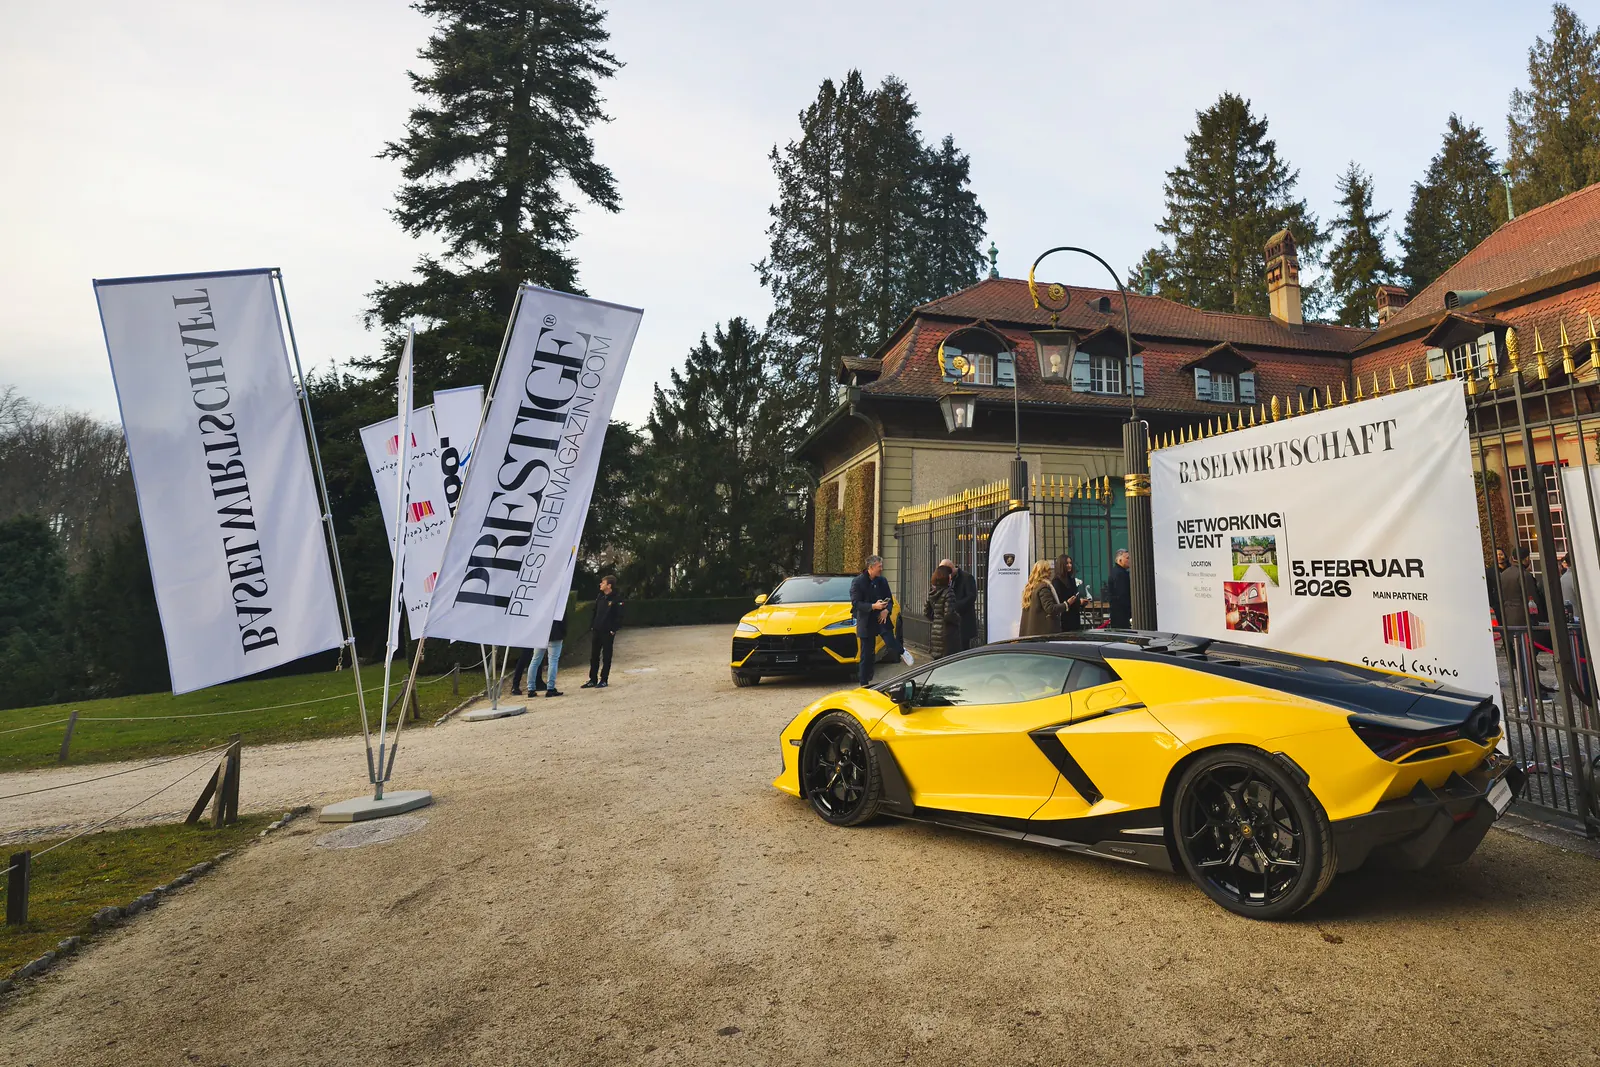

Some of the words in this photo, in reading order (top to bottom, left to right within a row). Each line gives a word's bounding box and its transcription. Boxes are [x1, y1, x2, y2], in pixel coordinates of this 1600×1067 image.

[1179, 418, 1398, 484] BASELWIRTSCHAFT
[509, 335, 613, 618] PRESTIGEMAGAZIN.COM
[1177, 512, 1282, 534] NETWORKING
[1178, 533, 1224, 549] EVENT
[1294, 579, 1352, 598] 2026
[1372, 590, 1392, 600] MAIN
[1392, 591, 1429, 601] PARTNER
[1411, 656, 1459, 678] Casino
